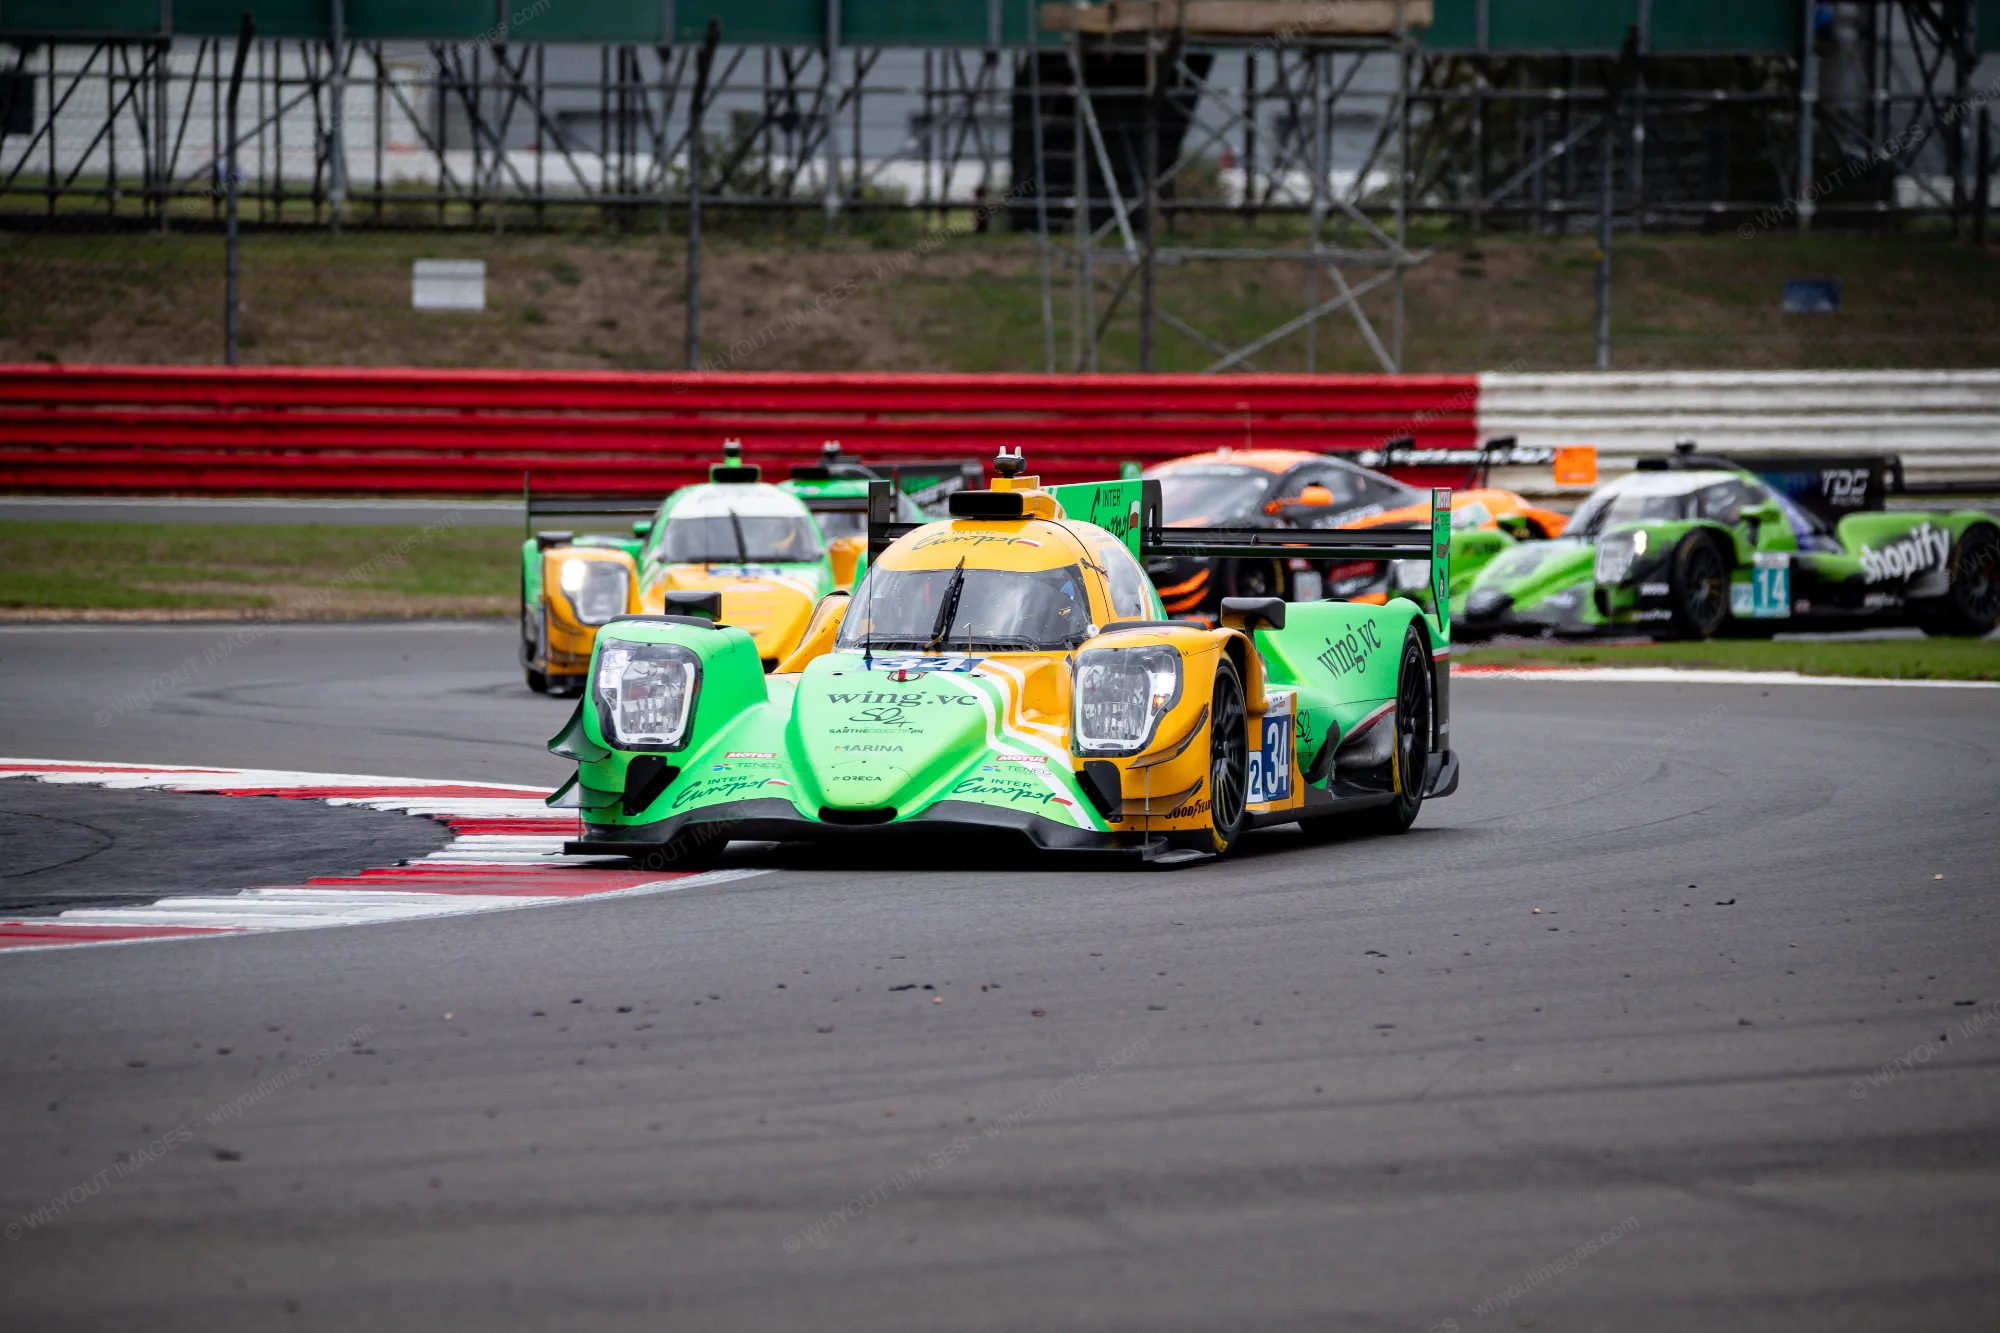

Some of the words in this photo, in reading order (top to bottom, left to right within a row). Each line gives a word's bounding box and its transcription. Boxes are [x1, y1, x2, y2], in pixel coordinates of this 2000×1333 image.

[1103, 488, 1121, 507] INTER
[912, 531, 1021, 551] Europol
[1860, 521, 1951, 585] shopify
[1758, 568, 1786, 609] 14
[1317, 618, 1381, 681] wing.vc
[877, 657, 963, 671] 34
[827, 690, 978, 708] wing.vc
[834, 744, 904, 752] MARINA
[1266, 720, 1288, 794] 34
[997, 755, 1046, 763] MOTUL
[708, 776, 747, 785] INTER
[991, 778, 1032, 788] INTER
[672, 778, 771, 809] Europol
[952, 777, 1056, 804] Europol
